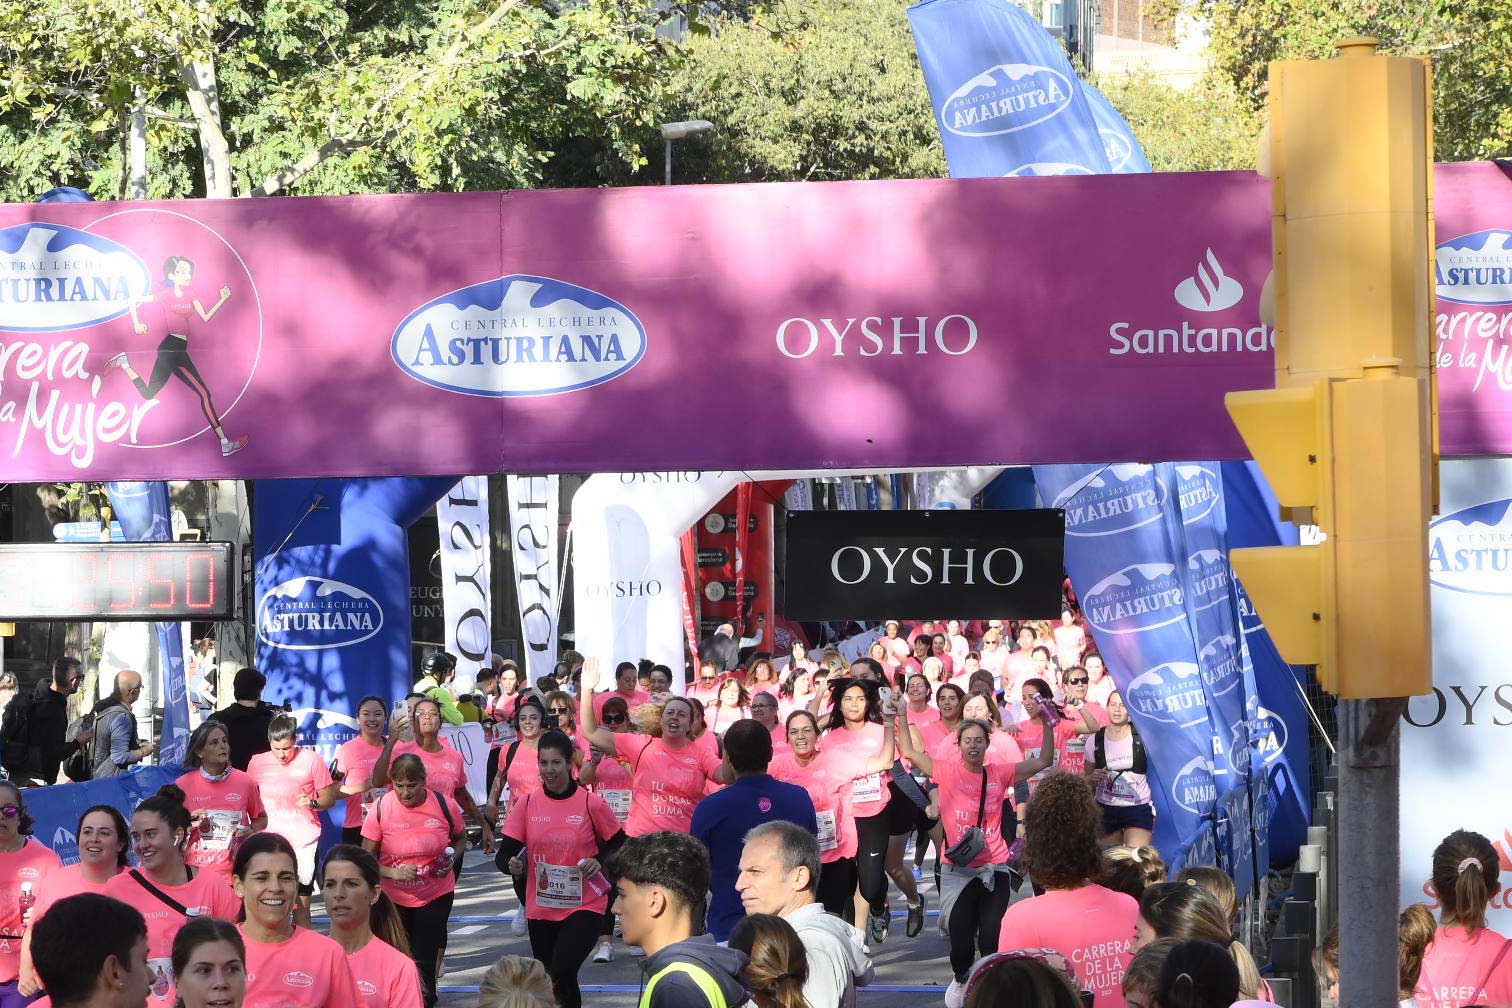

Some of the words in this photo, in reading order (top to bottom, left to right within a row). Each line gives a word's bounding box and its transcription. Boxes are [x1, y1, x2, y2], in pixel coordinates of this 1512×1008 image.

[450, 317, 529, 331] CENTRAL
[536, 314, 619, 329] LECHERA
[411, 322, 627, 367] ASTURIANA
[775, 314, 979, 359] OYSHO
[1458, 342, 1477, 368] la
[14, 374, 161, 468] Mujer
[448, 479, 488, 662] OYSH
[516, 475, 552, 652] OYSH
[830, 545, 1024, 587] OYSHO
[586, 579, 662, 598] OYSHO
[274, 601, 316, 611] CENTRAL
[320, 601, 370, 609] LECHERA
[262, 606, 375, 633] ASTURIANA
[651, 782, 665, 792] TU
[652, 804, 684, 816] SUMA
[1071, 939, 1131, 963] CARRERA
[1085, 960, 1102, 976] DE
[1106, 956, 1123, 972] LA
